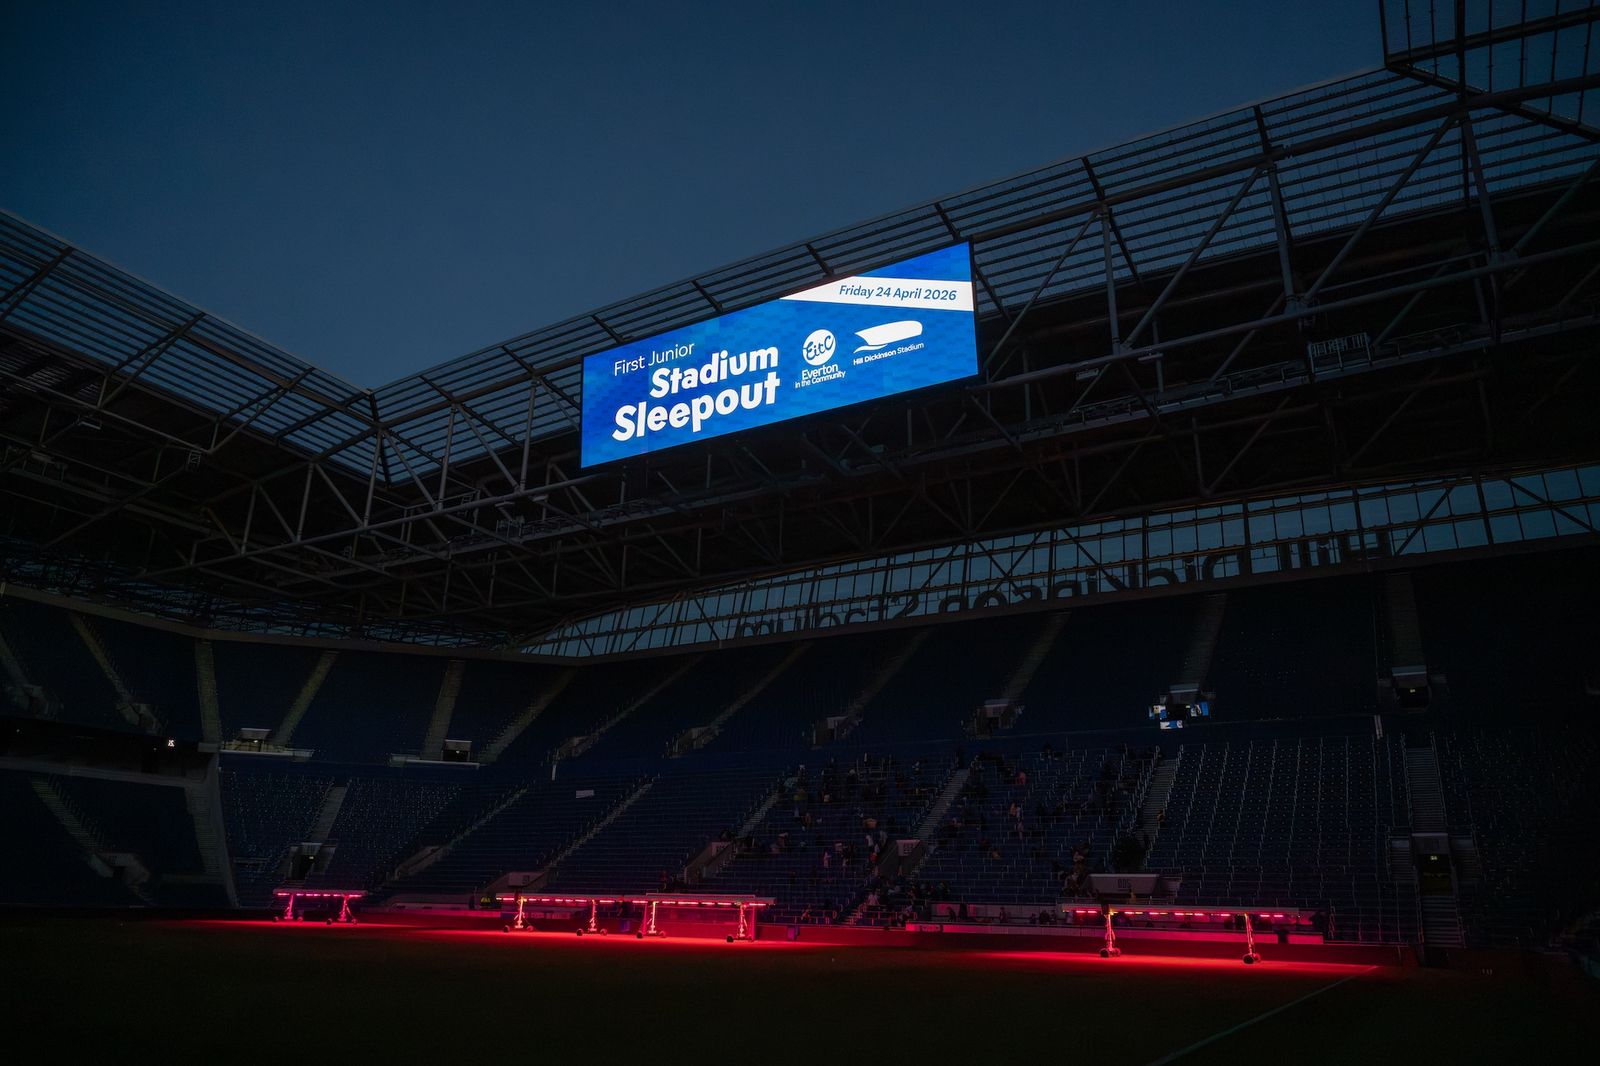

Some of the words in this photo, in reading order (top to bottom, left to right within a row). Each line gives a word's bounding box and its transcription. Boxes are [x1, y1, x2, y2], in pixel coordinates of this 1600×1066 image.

[839, 285, 875, 299] Friday
[875, 286, 891, 298] 24
[893, 287, 922, 301] April
[923, 288, 957, 301] 2026
[614, 356, 645, 377] First
[648, 343, 695, 367] Junior
[853, 357, 864, 366] Hill
[864, 350, 897, 363] Dickinson
[897, 343, 925, 354] Stadium
[649, 346, 779, 399] Stadium
[795, 380, 801, 389] in
[801, 378, 811, 387] the
[812, 370, 846, 385] Community
[802, 363, 839, 381] Everton
[612, 372, 781, 442] Sleepout
